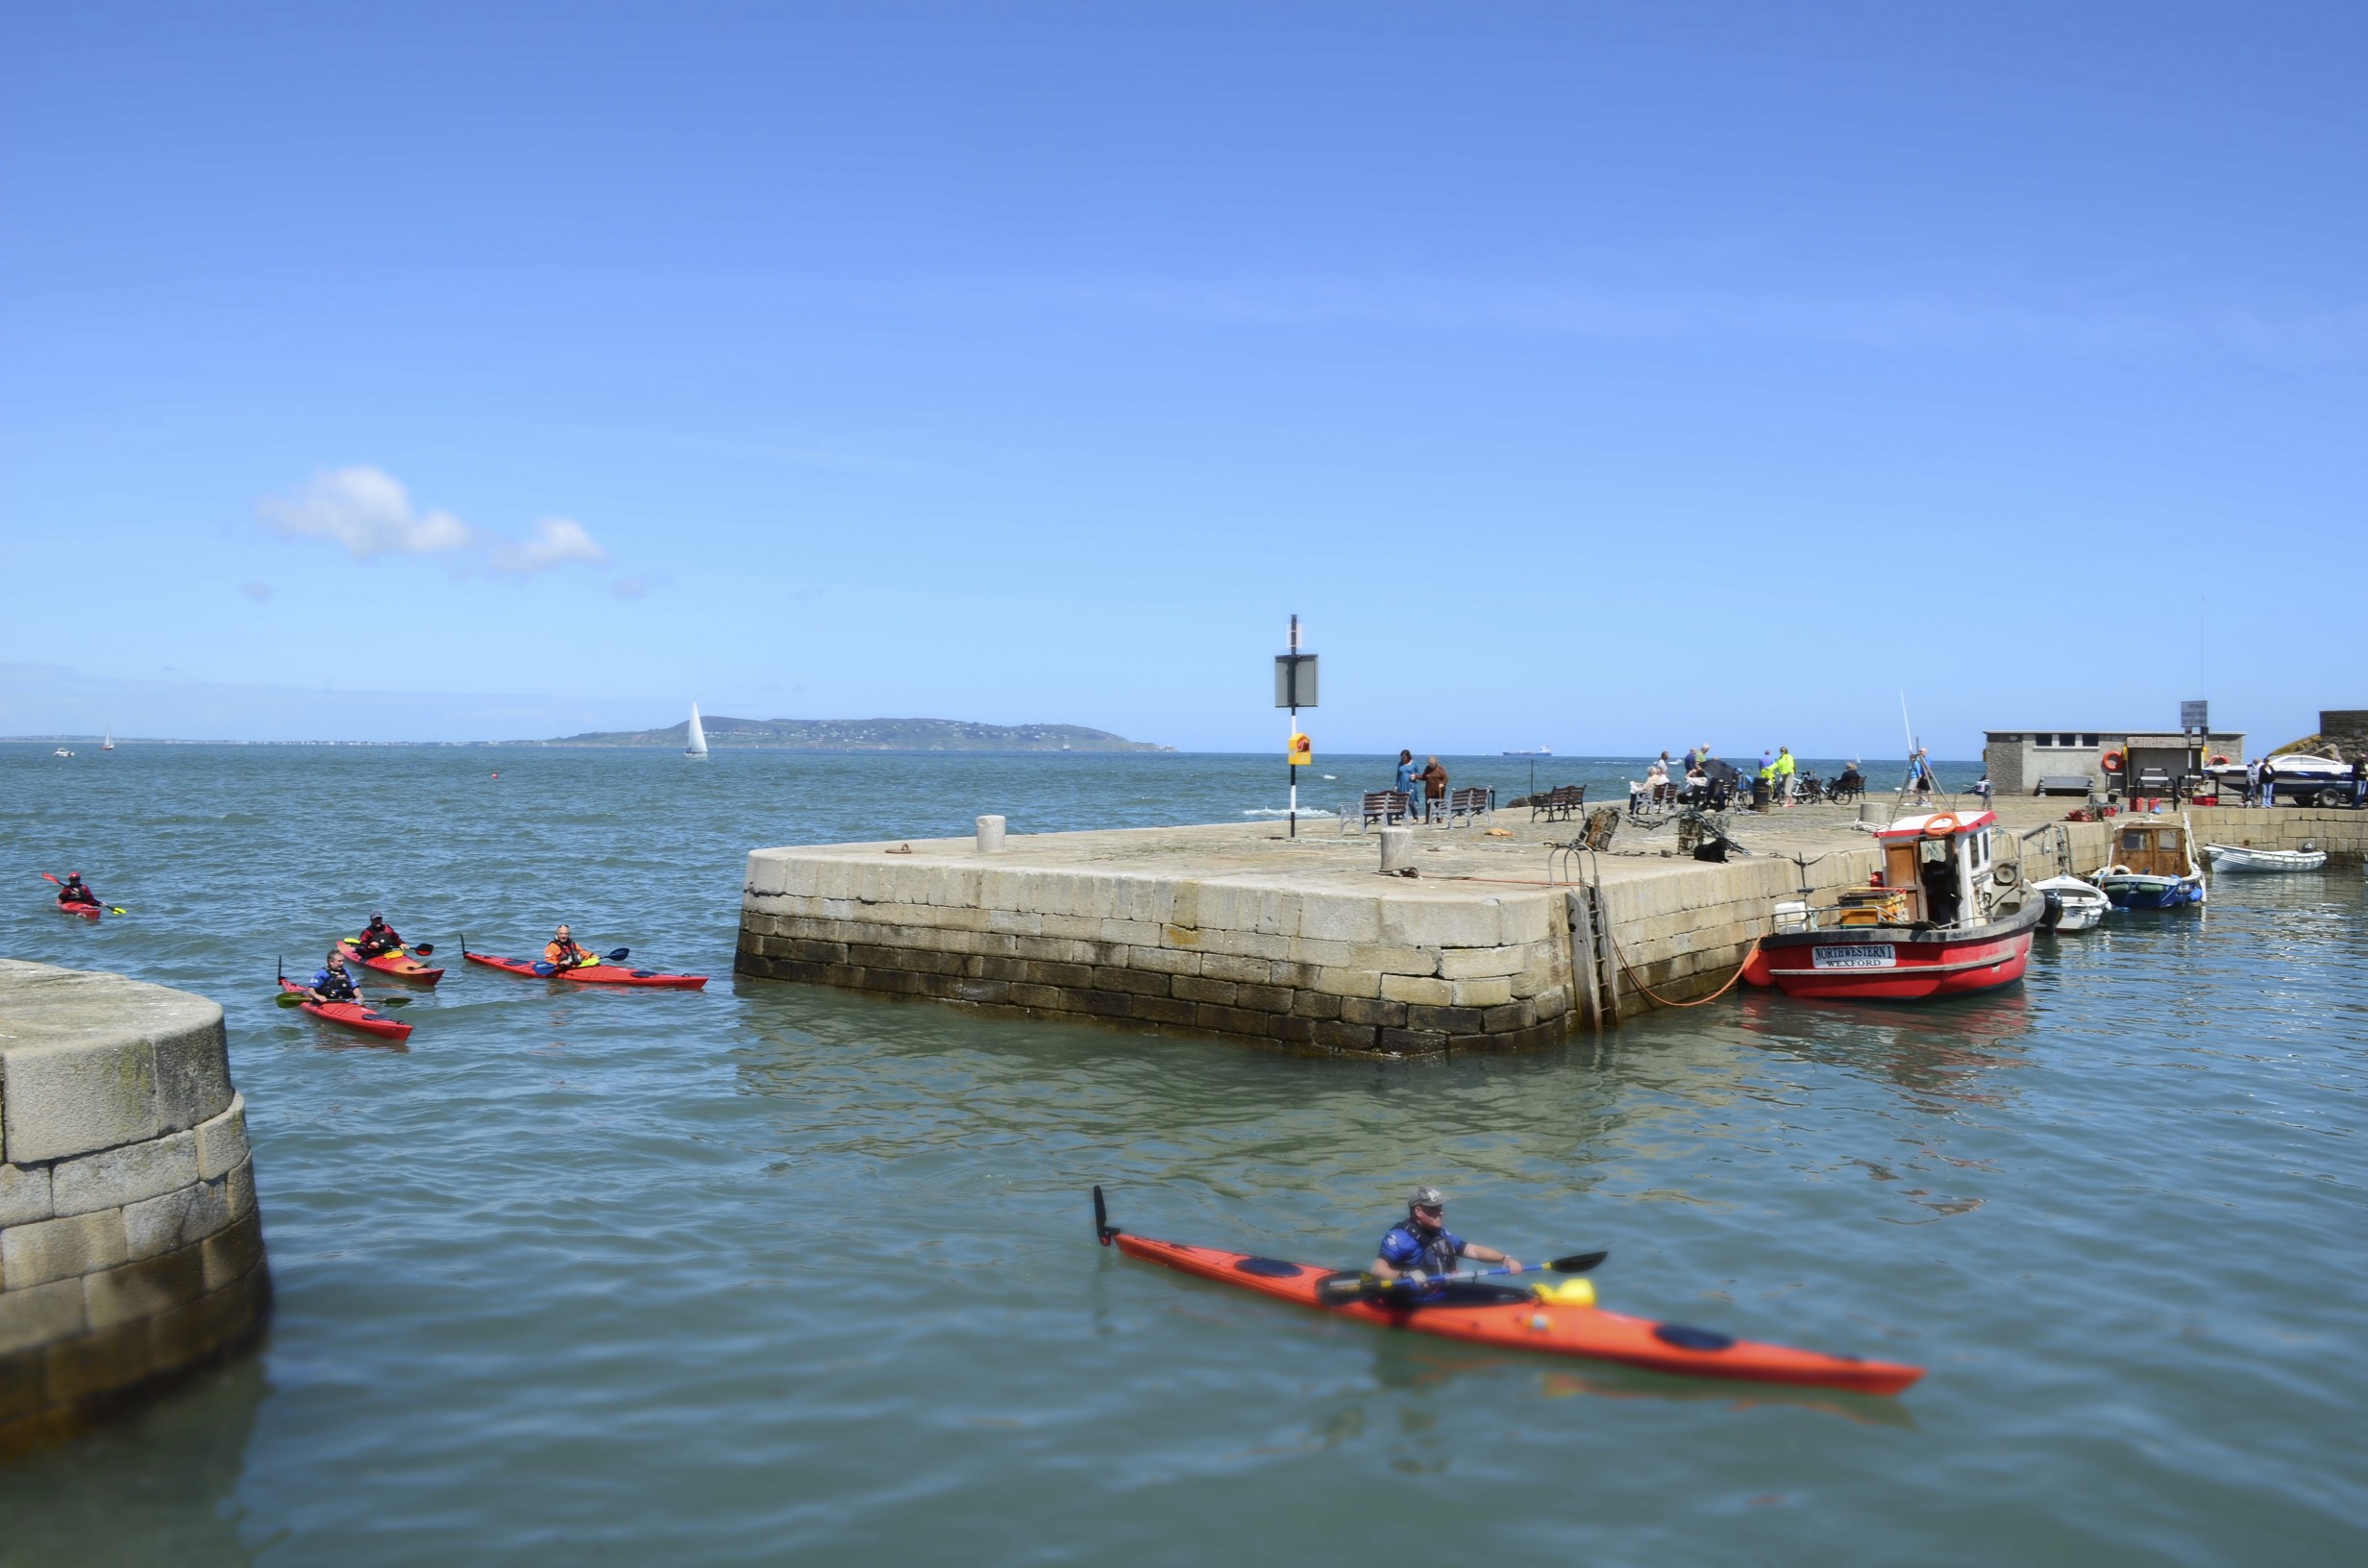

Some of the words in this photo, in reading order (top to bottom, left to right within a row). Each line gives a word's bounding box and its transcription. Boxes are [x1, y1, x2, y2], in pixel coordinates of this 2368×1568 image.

[1815, 946, 1886, 961] NORTHWESTERN
[1887, 945, 1892, 959] I
[1826, 959, 1882, 968] WEXFORD
